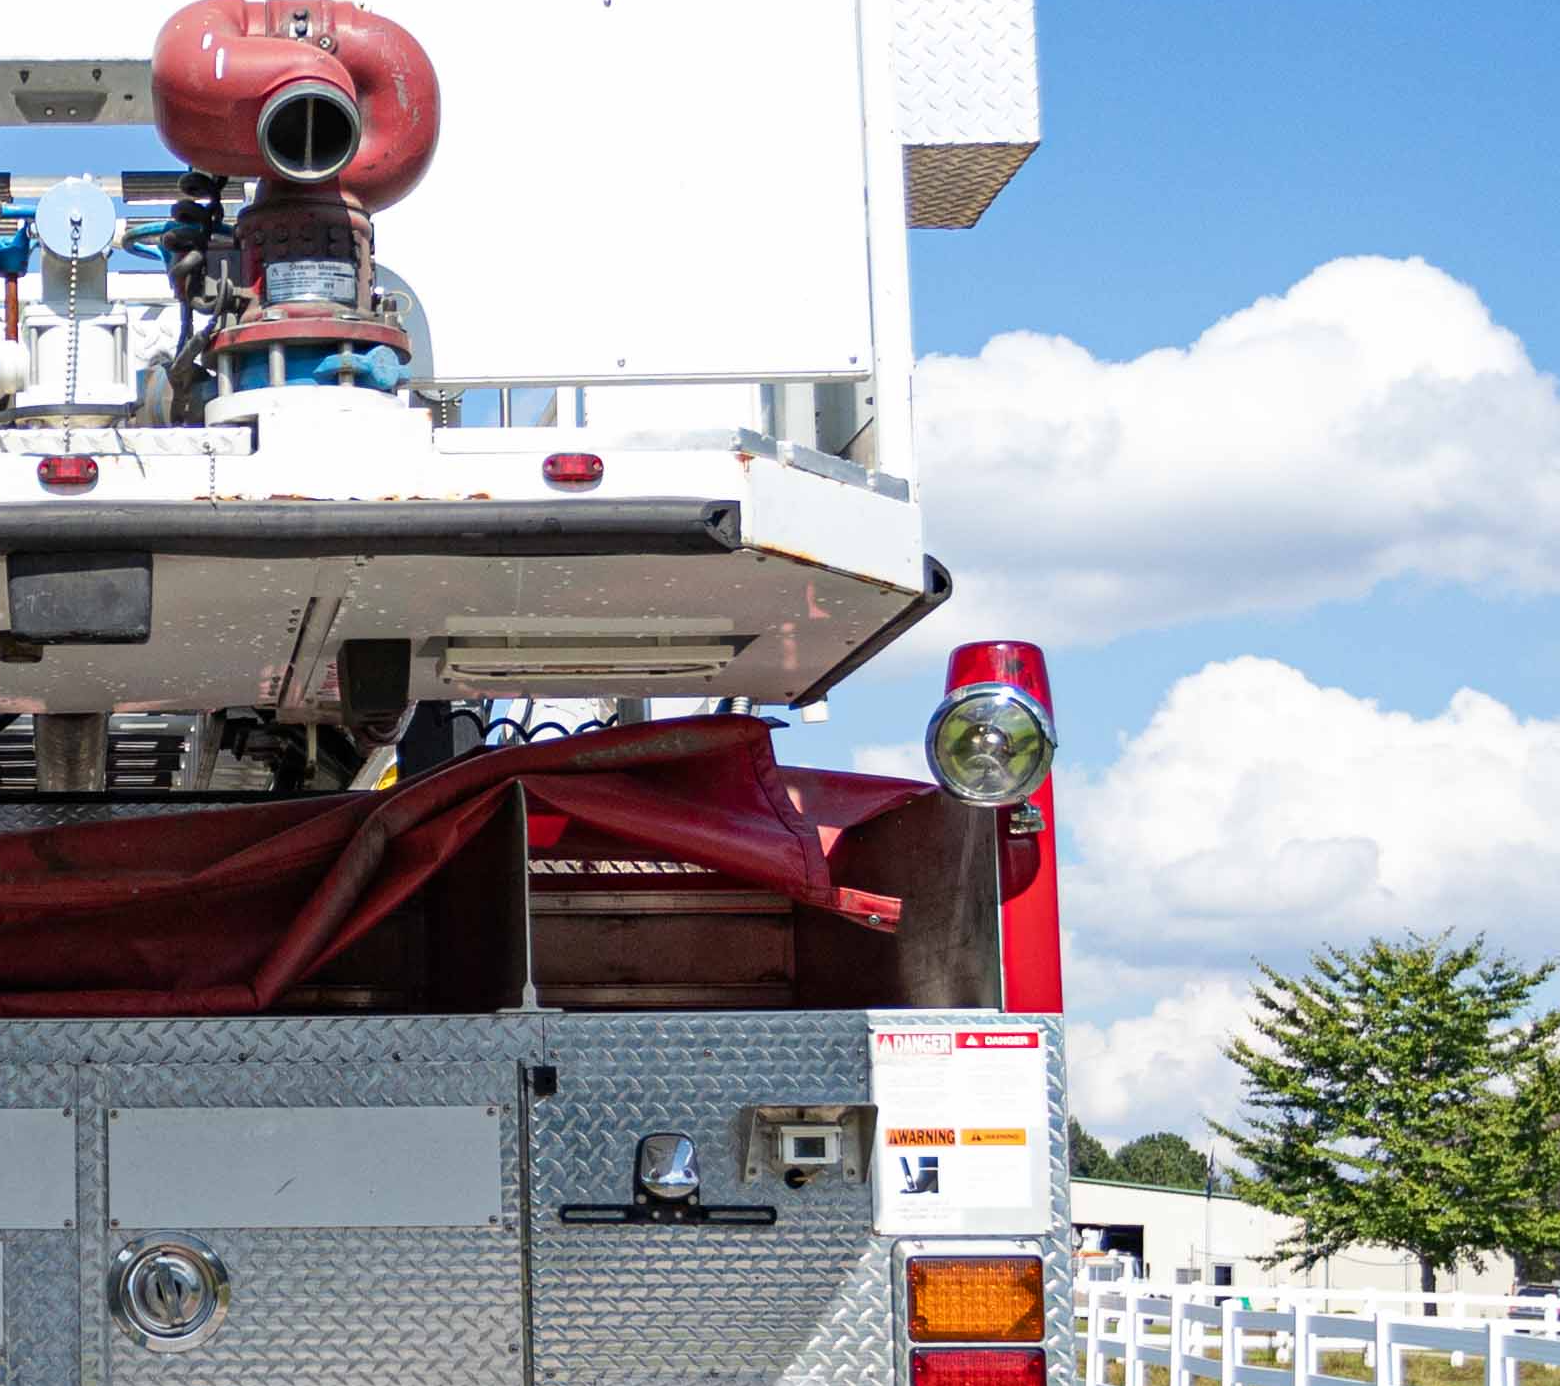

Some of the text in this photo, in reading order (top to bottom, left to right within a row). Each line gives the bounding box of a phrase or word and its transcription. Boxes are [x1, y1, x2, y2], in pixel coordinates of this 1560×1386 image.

[893, 1035, 951, 1055] DANGER
[984, 1035, 1029, 1046] DANGER
[898, 1129, 955, 1145] WARNING
